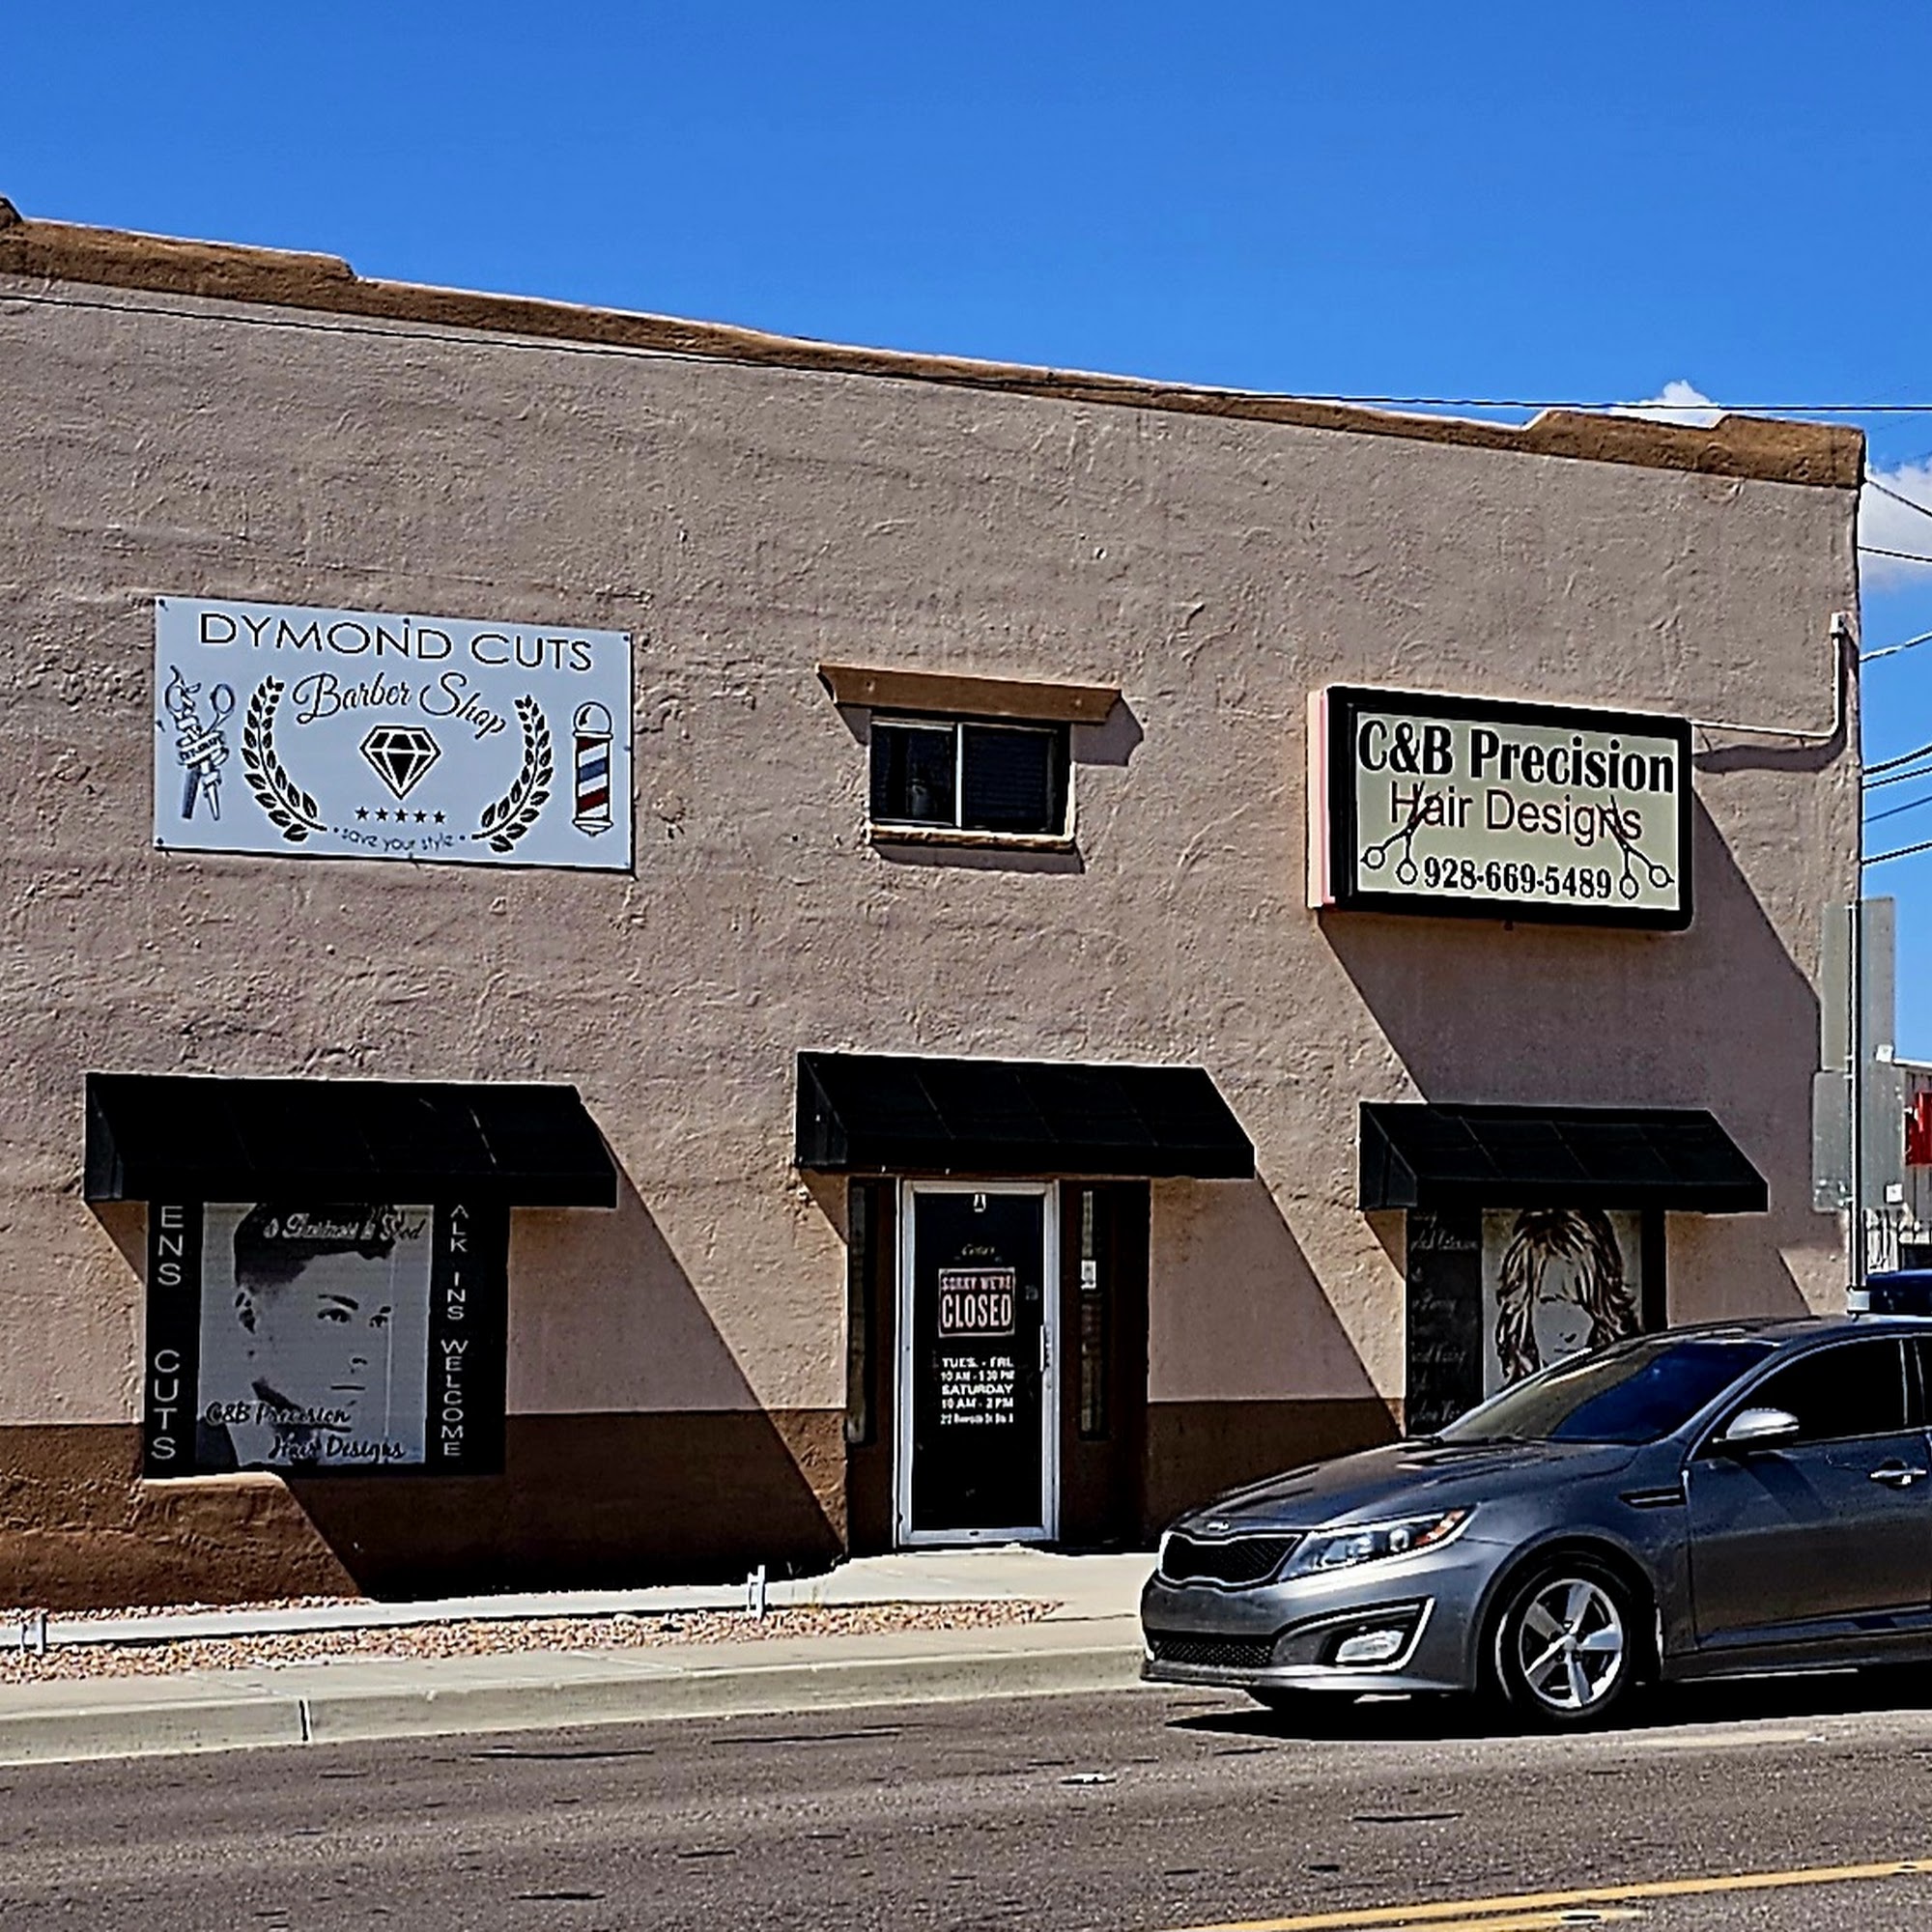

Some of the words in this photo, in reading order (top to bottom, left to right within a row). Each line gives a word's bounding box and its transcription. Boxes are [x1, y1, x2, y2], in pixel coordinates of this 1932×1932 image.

[200, 613, 452, 661] DYMOND
[470, 634, 593, 671] CUTS
[292, 672, 412, 725] Barber
[419, 672, 507, 740] Shop
[1358, 720, 1453, 775] C&B
[1469, 728, 1674, 794] Precision
[1391, 781, 1473, 829] Hair
[1486, 788, 1643, 848] Designs
[383, 838, 416, 852] your
[421, 832, 455, 852] style
[1423, 856, 1611, 899] 928-669-5489
[446, 1271, 466, 1321] INS
[942, 1293, 1012, 1328] CLOSED
[151, 1349, 181, 1460] CUTS
[255, 1402, 351, 1427] Precision
[440, 1339, 469, 1456] WELCOME
[941, 1383, 1014, 1396] SATURDAY
[327, 1435, 405, 1462] Designs
